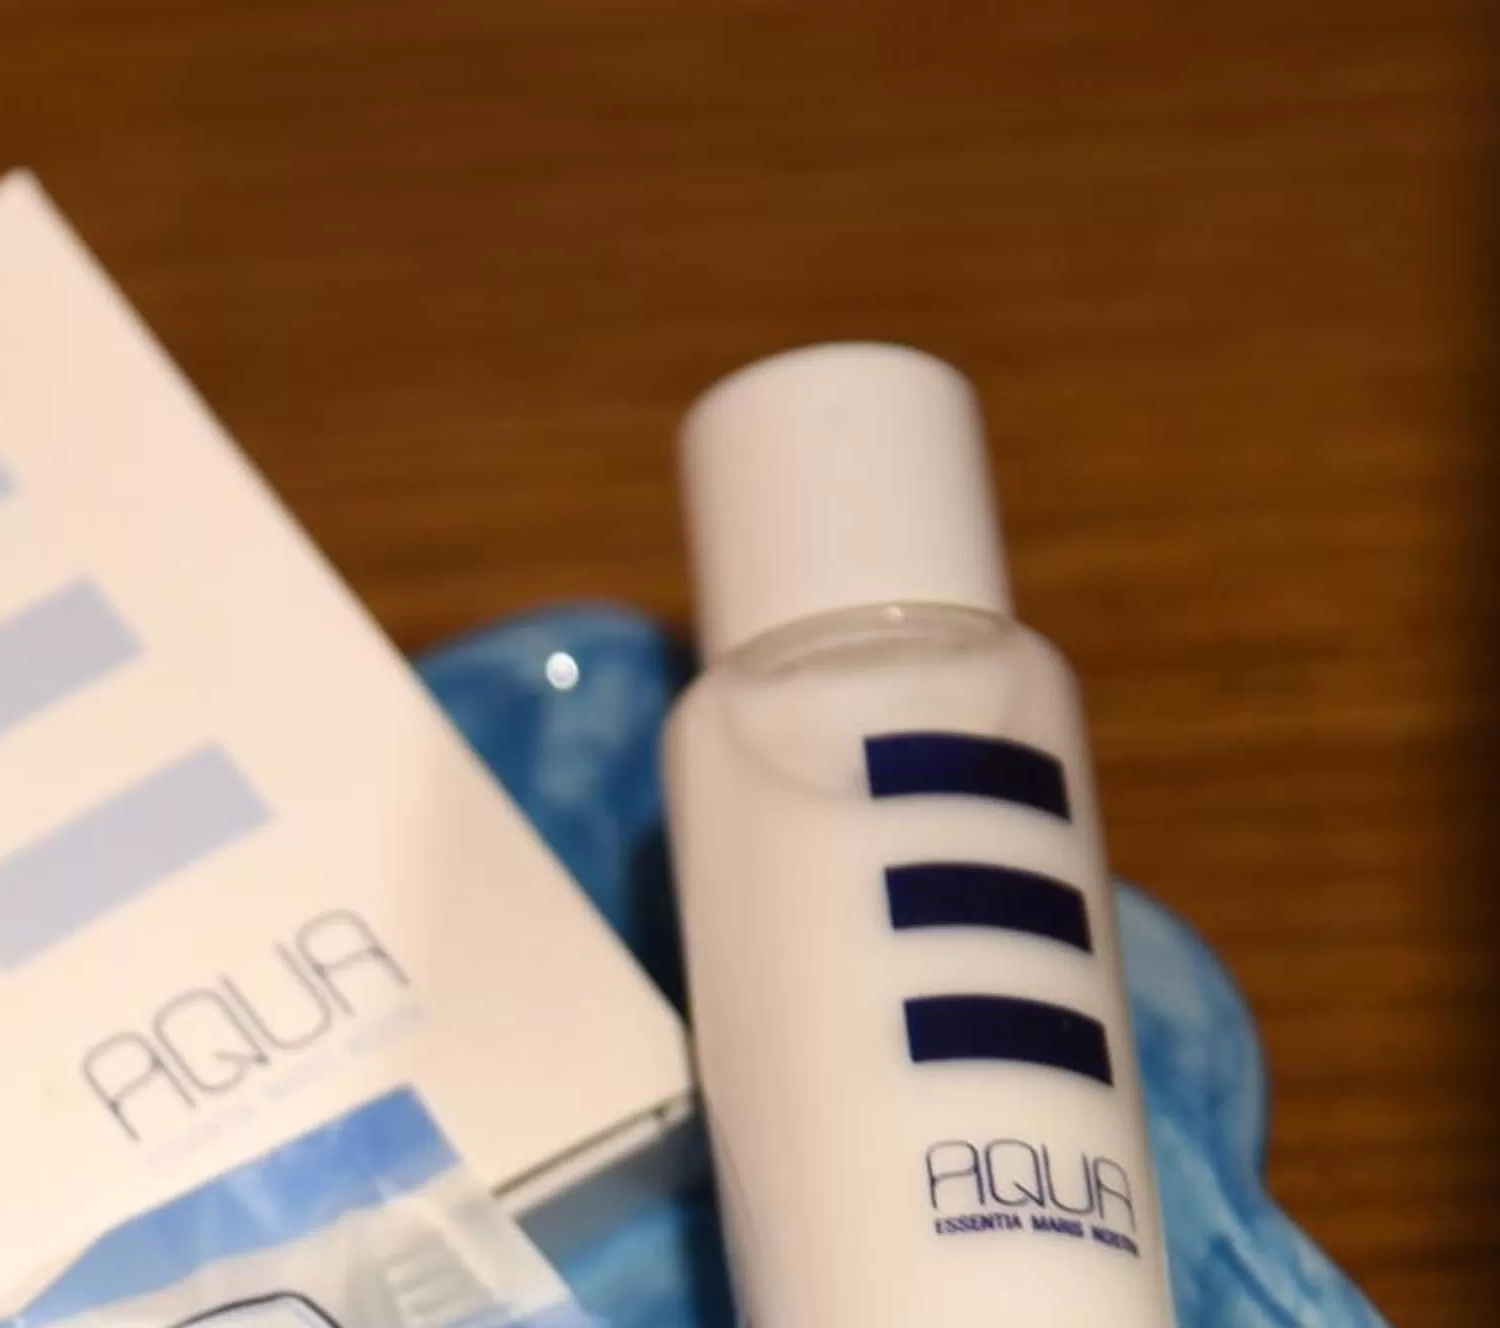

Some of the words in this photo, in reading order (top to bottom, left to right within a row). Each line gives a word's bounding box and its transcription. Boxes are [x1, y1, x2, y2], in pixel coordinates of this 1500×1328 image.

[82, 908, 411, 1142] AQUA
[926, 1136, 1137, 1233] AQUA
[935, 1212, 1023, 1235] ESSENTIA
